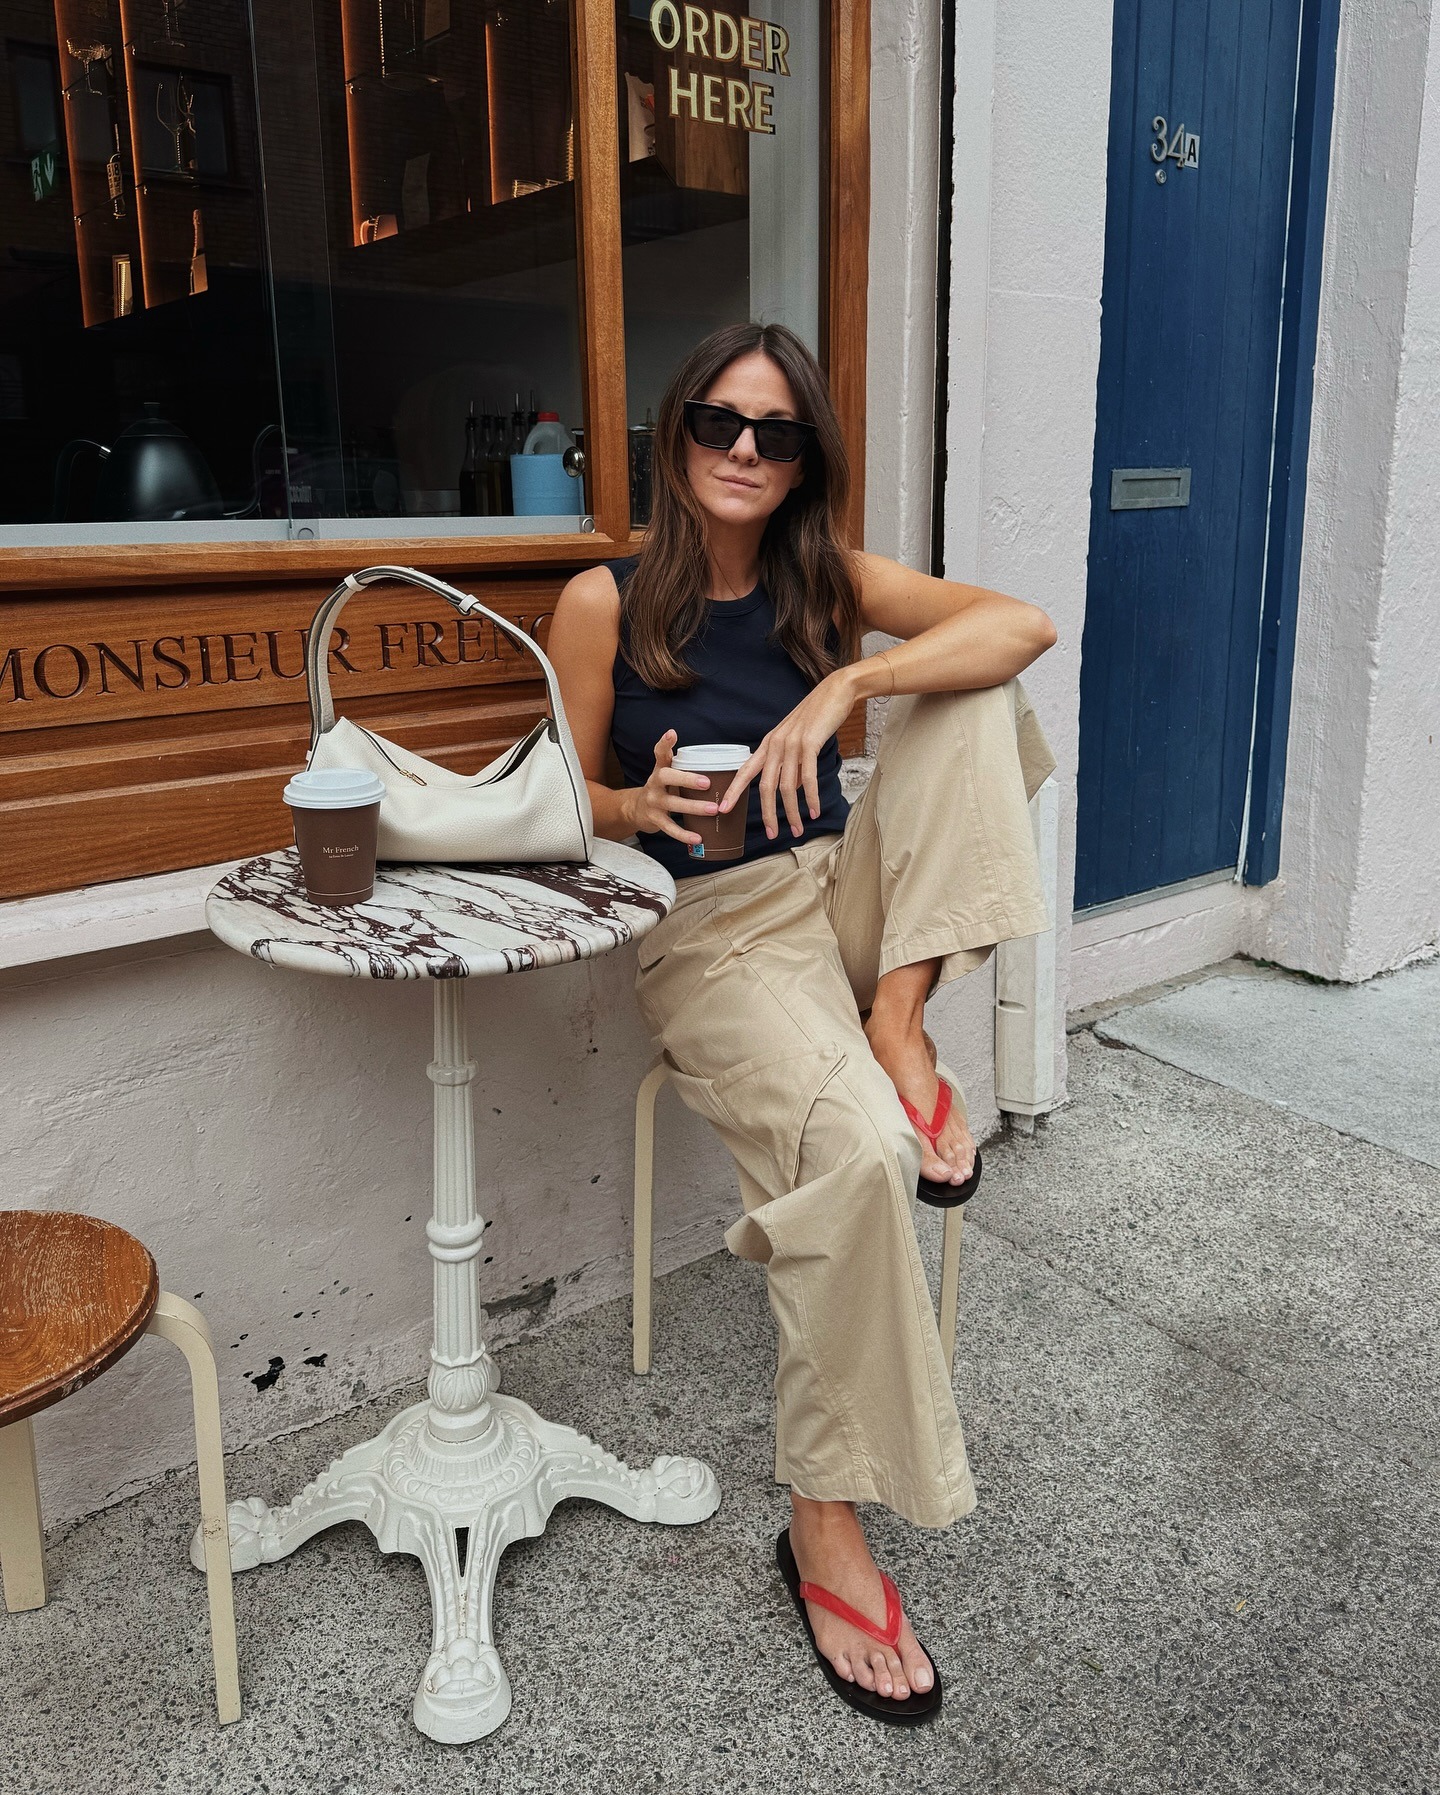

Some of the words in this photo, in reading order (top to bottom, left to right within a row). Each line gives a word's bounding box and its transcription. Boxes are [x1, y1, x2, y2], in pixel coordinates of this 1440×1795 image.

[650, 0, 791, 76] ORDER
[668, 66, 776, 135] HERE
[335, 844, 359, 853] French
